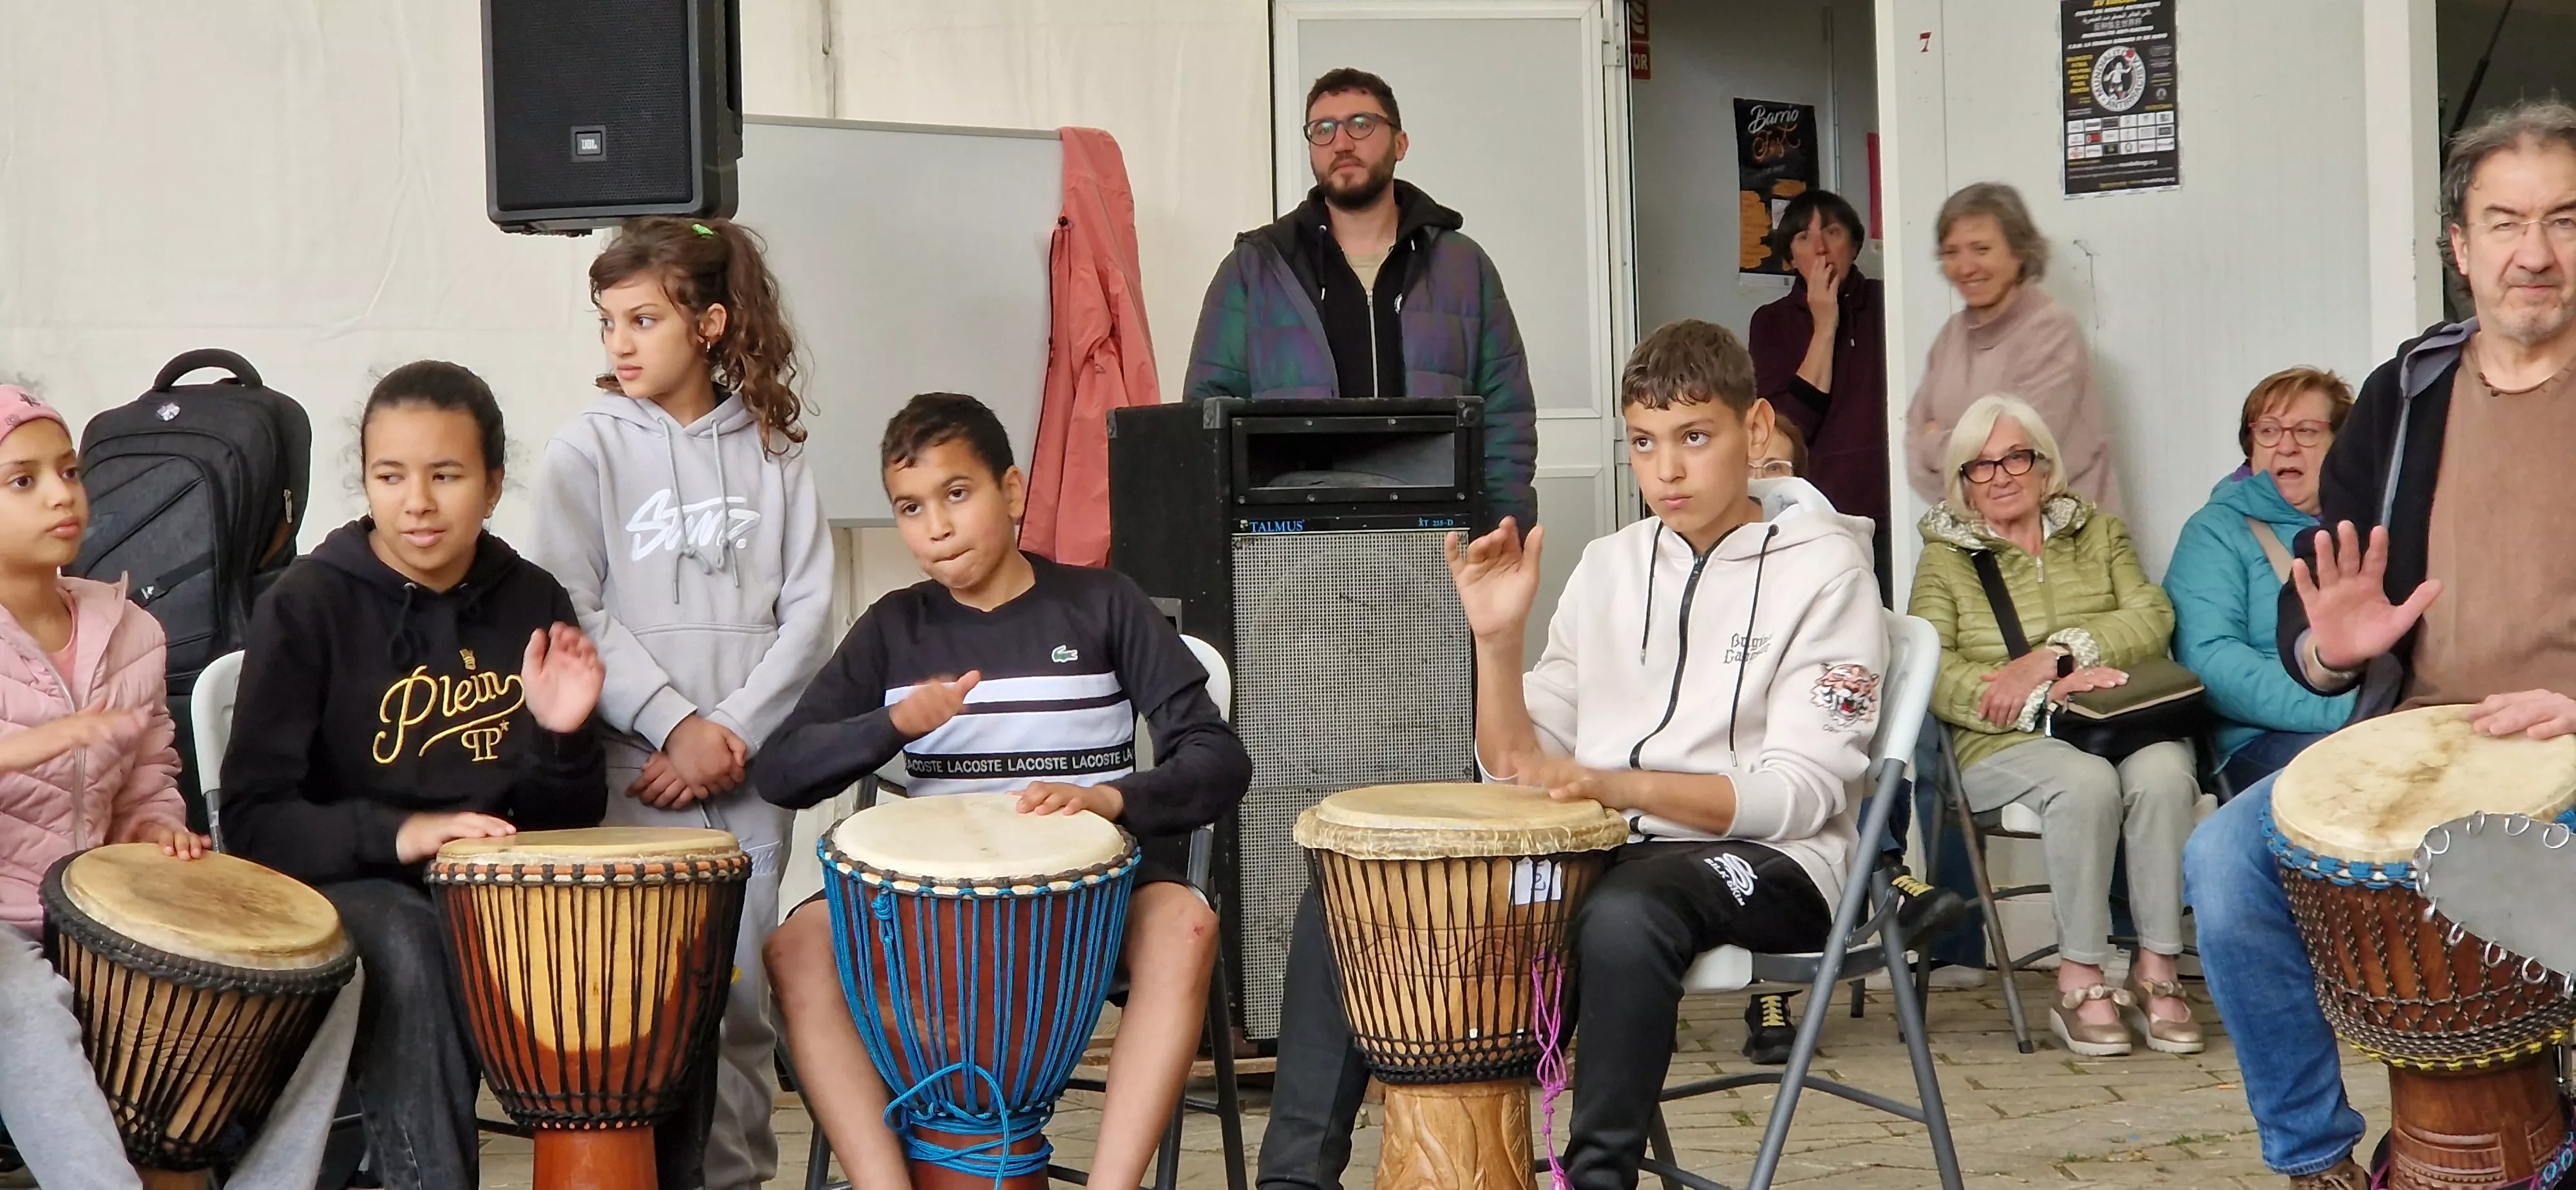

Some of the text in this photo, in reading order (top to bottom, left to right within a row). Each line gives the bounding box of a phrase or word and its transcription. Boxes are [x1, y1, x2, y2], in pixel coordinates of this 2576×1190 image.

[1919, 32, 1932, 53] 7
[1630, 53, 1647, 70] OR
[1747, 104, 1799, 134] Barrio
[581, 138, 598, 150] JBL
[1249, 520, 1303, 533] TALMUS
[372, 665, 526, 764] Plein
[947, 759, 1002, 773] LACOSTE
[1007, 756, 1068, 772] LACOSTE
[1072, 751, 1121, 770] LACOSTE
